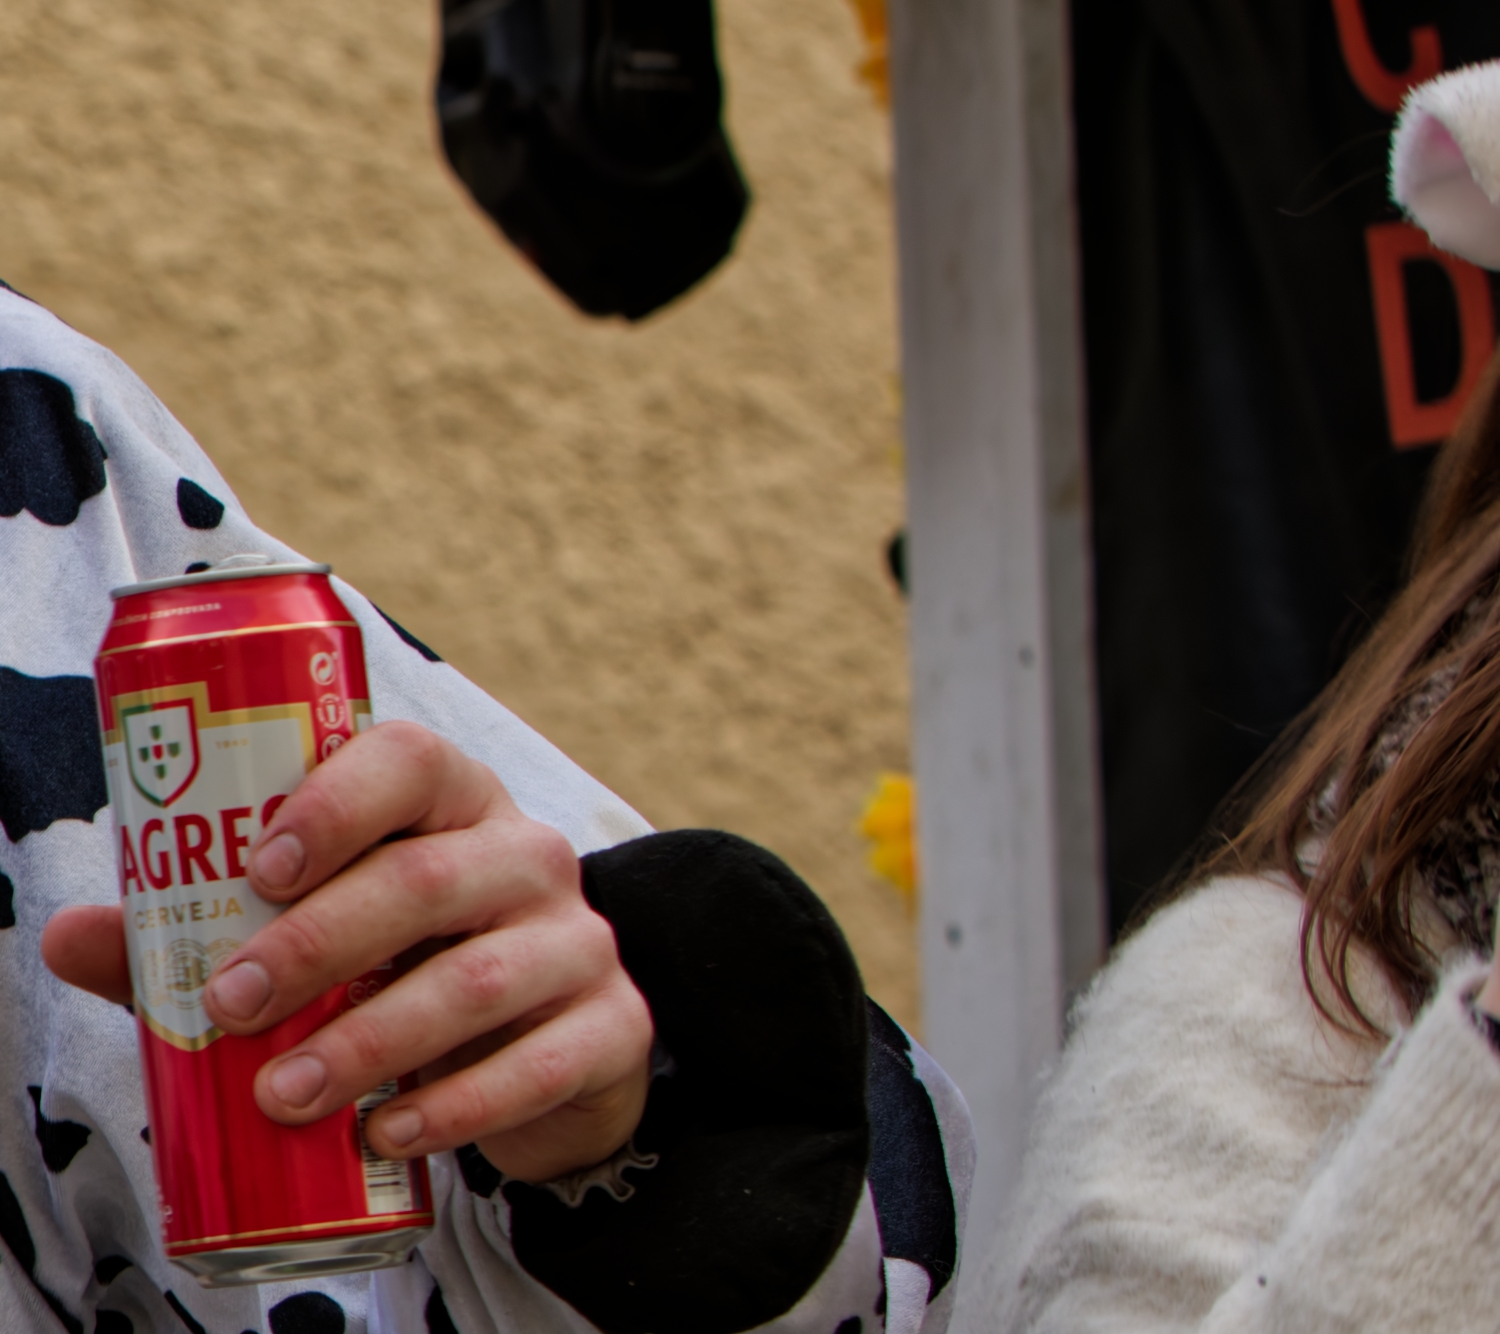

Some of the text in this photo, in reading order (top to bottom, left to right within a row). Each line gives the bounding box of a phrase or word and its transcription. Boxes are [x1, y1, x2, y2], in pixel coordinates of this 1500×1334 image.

[1364, 221, 1500, 452] D
[120, 794, 290, 896] AGRE
[134, 897, 244, 930] CERVEJA
